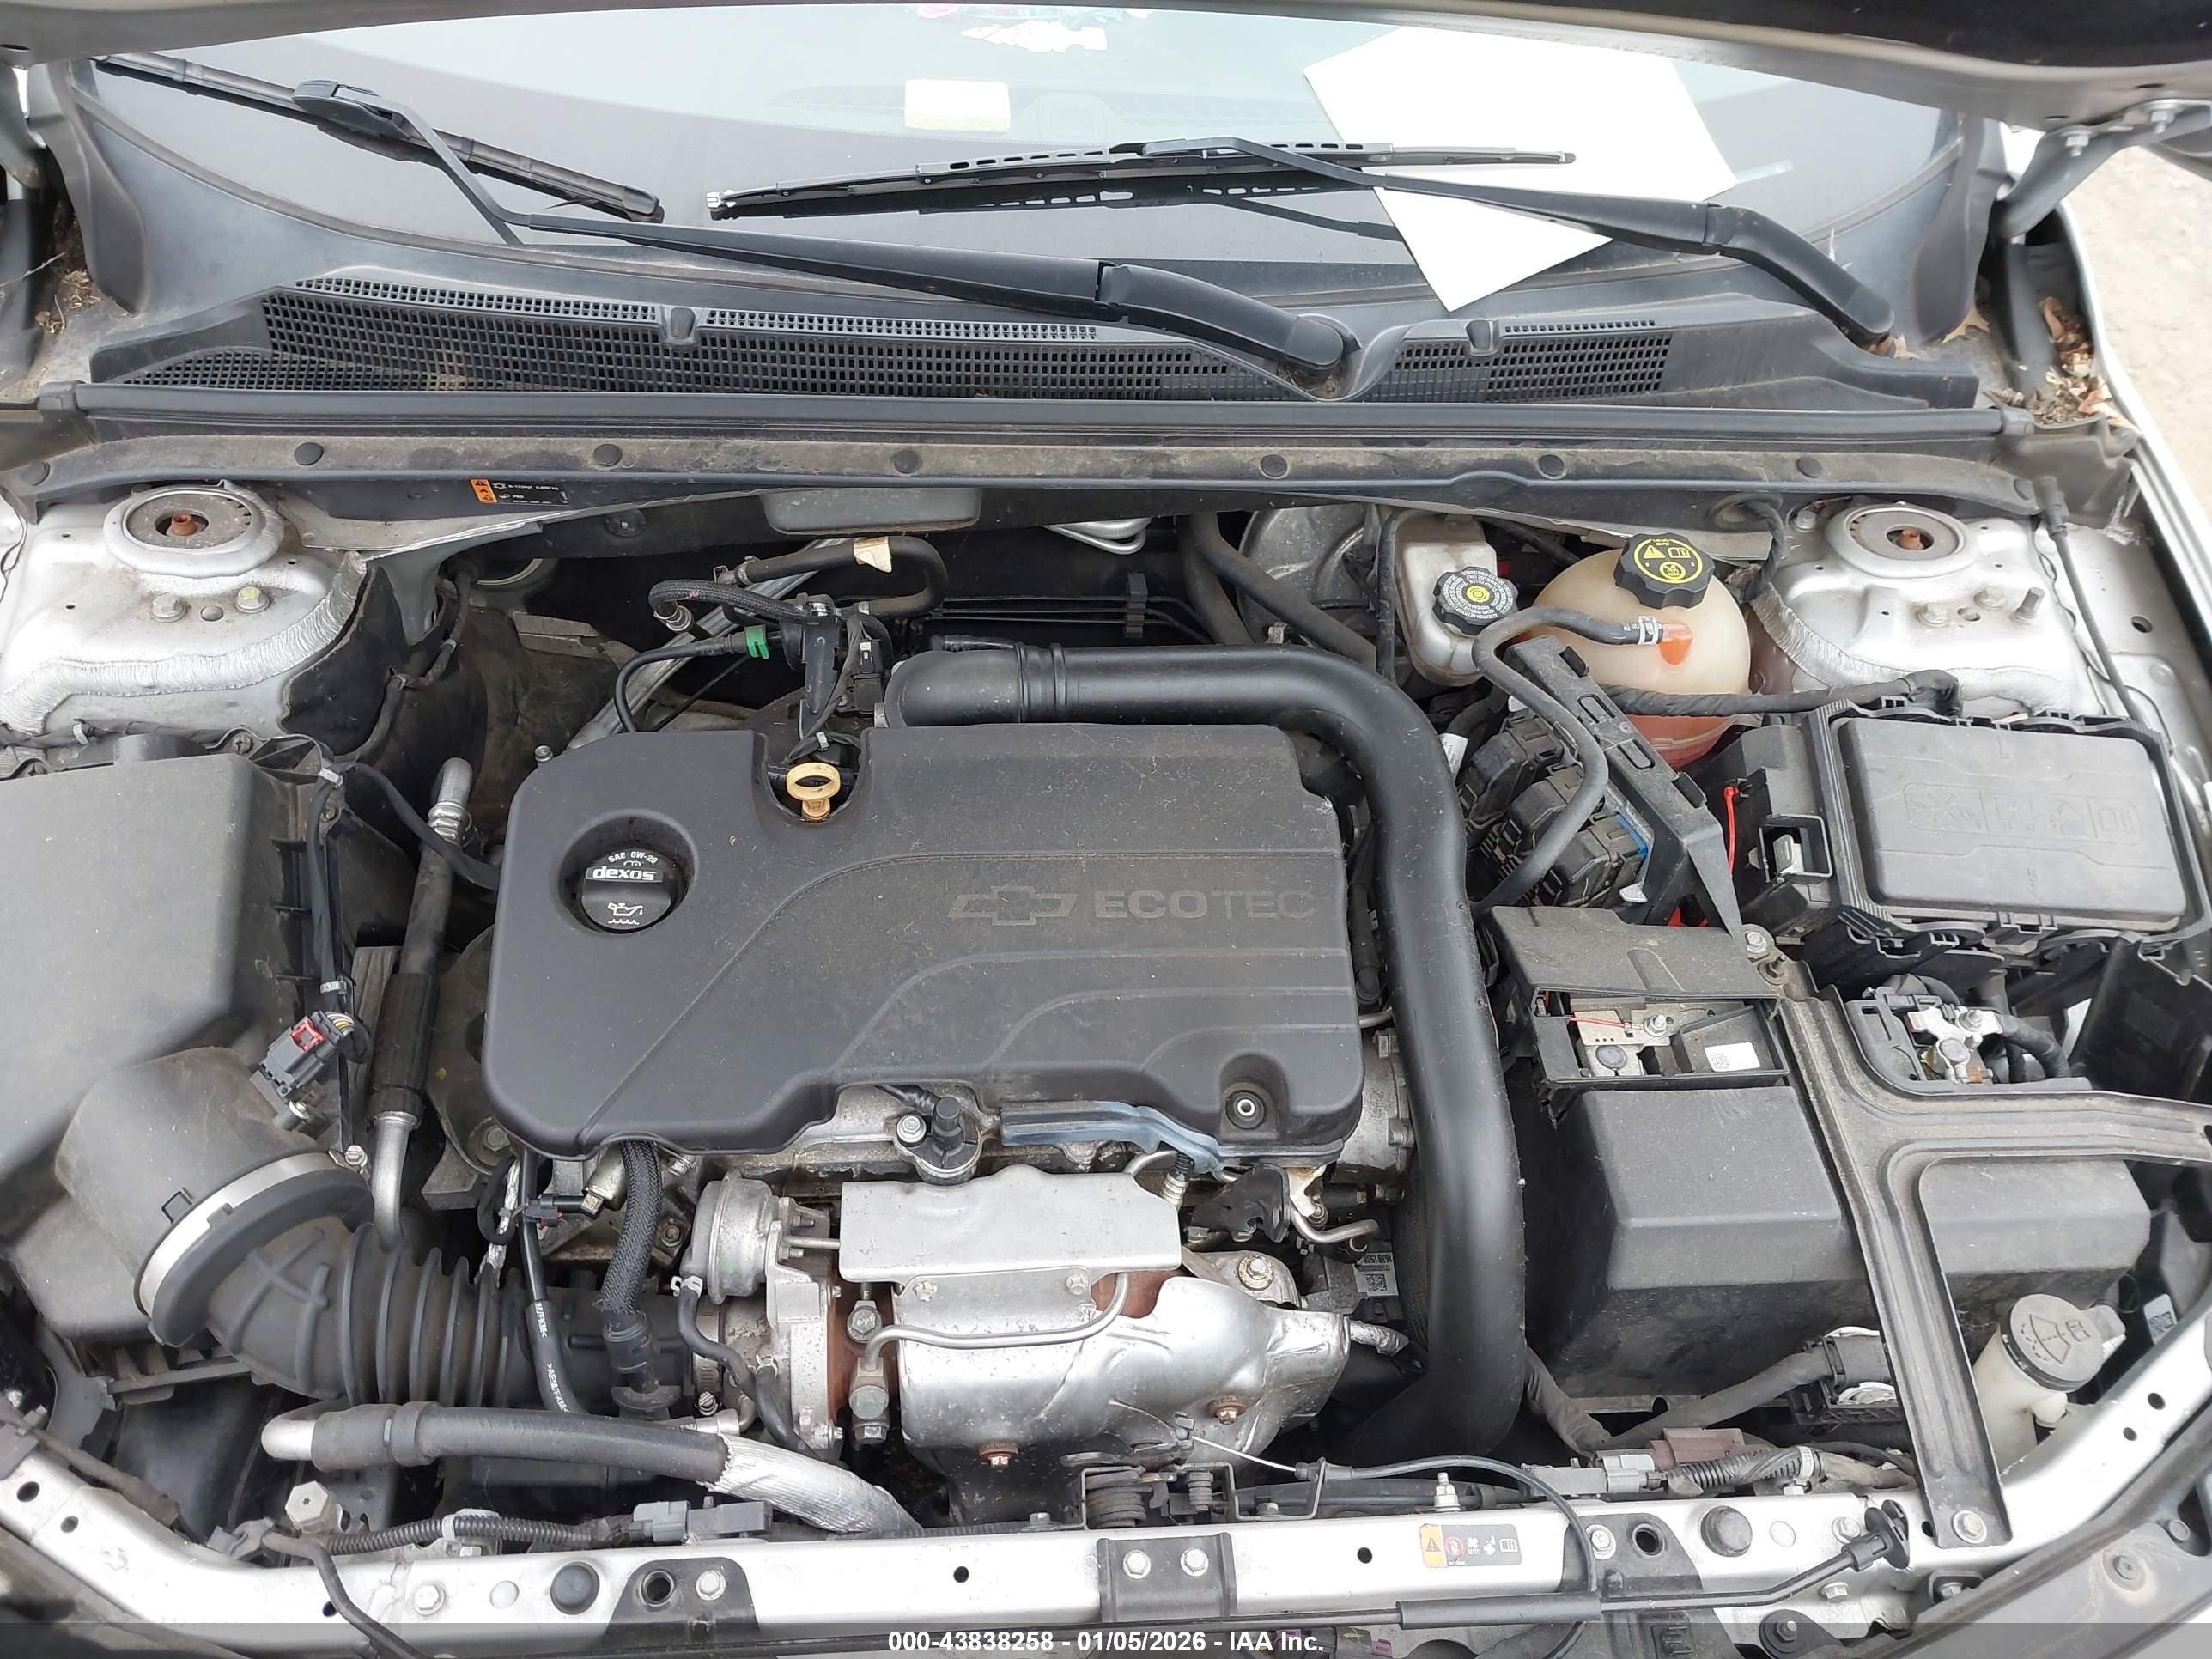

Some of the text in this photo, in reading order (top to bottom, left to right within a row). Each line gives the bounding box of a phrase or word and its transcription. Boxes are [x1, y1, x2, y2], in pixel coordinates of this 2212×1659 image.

[608, 851, 659, 864] SAE 0W-20
[592, 866, 658, 881] dexos
[1095, 889, 1315, 920] ECOTEC
